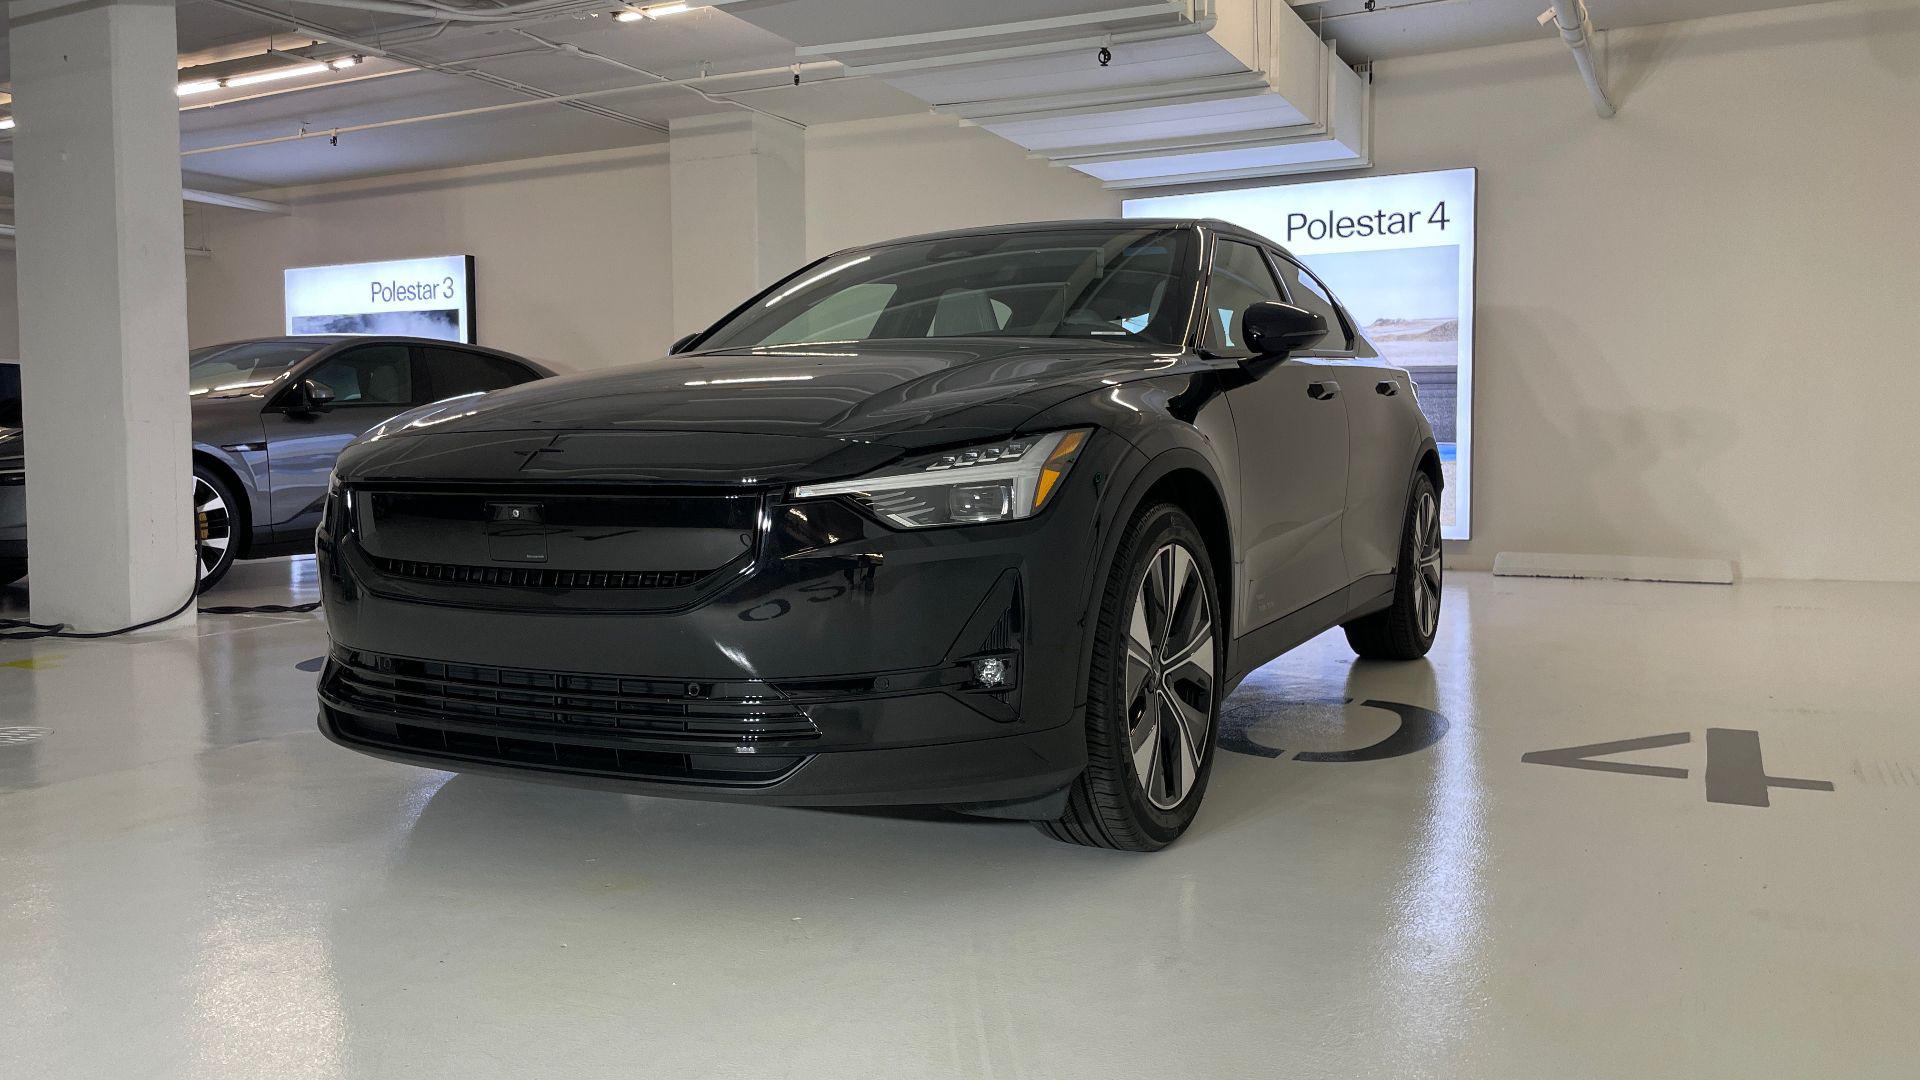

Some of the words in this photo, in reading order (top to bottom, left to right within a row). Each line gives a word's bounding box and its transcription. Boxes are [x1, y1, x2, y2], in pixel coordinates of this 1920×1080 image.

[1287, 209, 1421, 242] Polestar
[1427, 200, 1450, 231] 4
[371, 280, 439, 302] Polestar
[442, 276, 455, 299] 3
